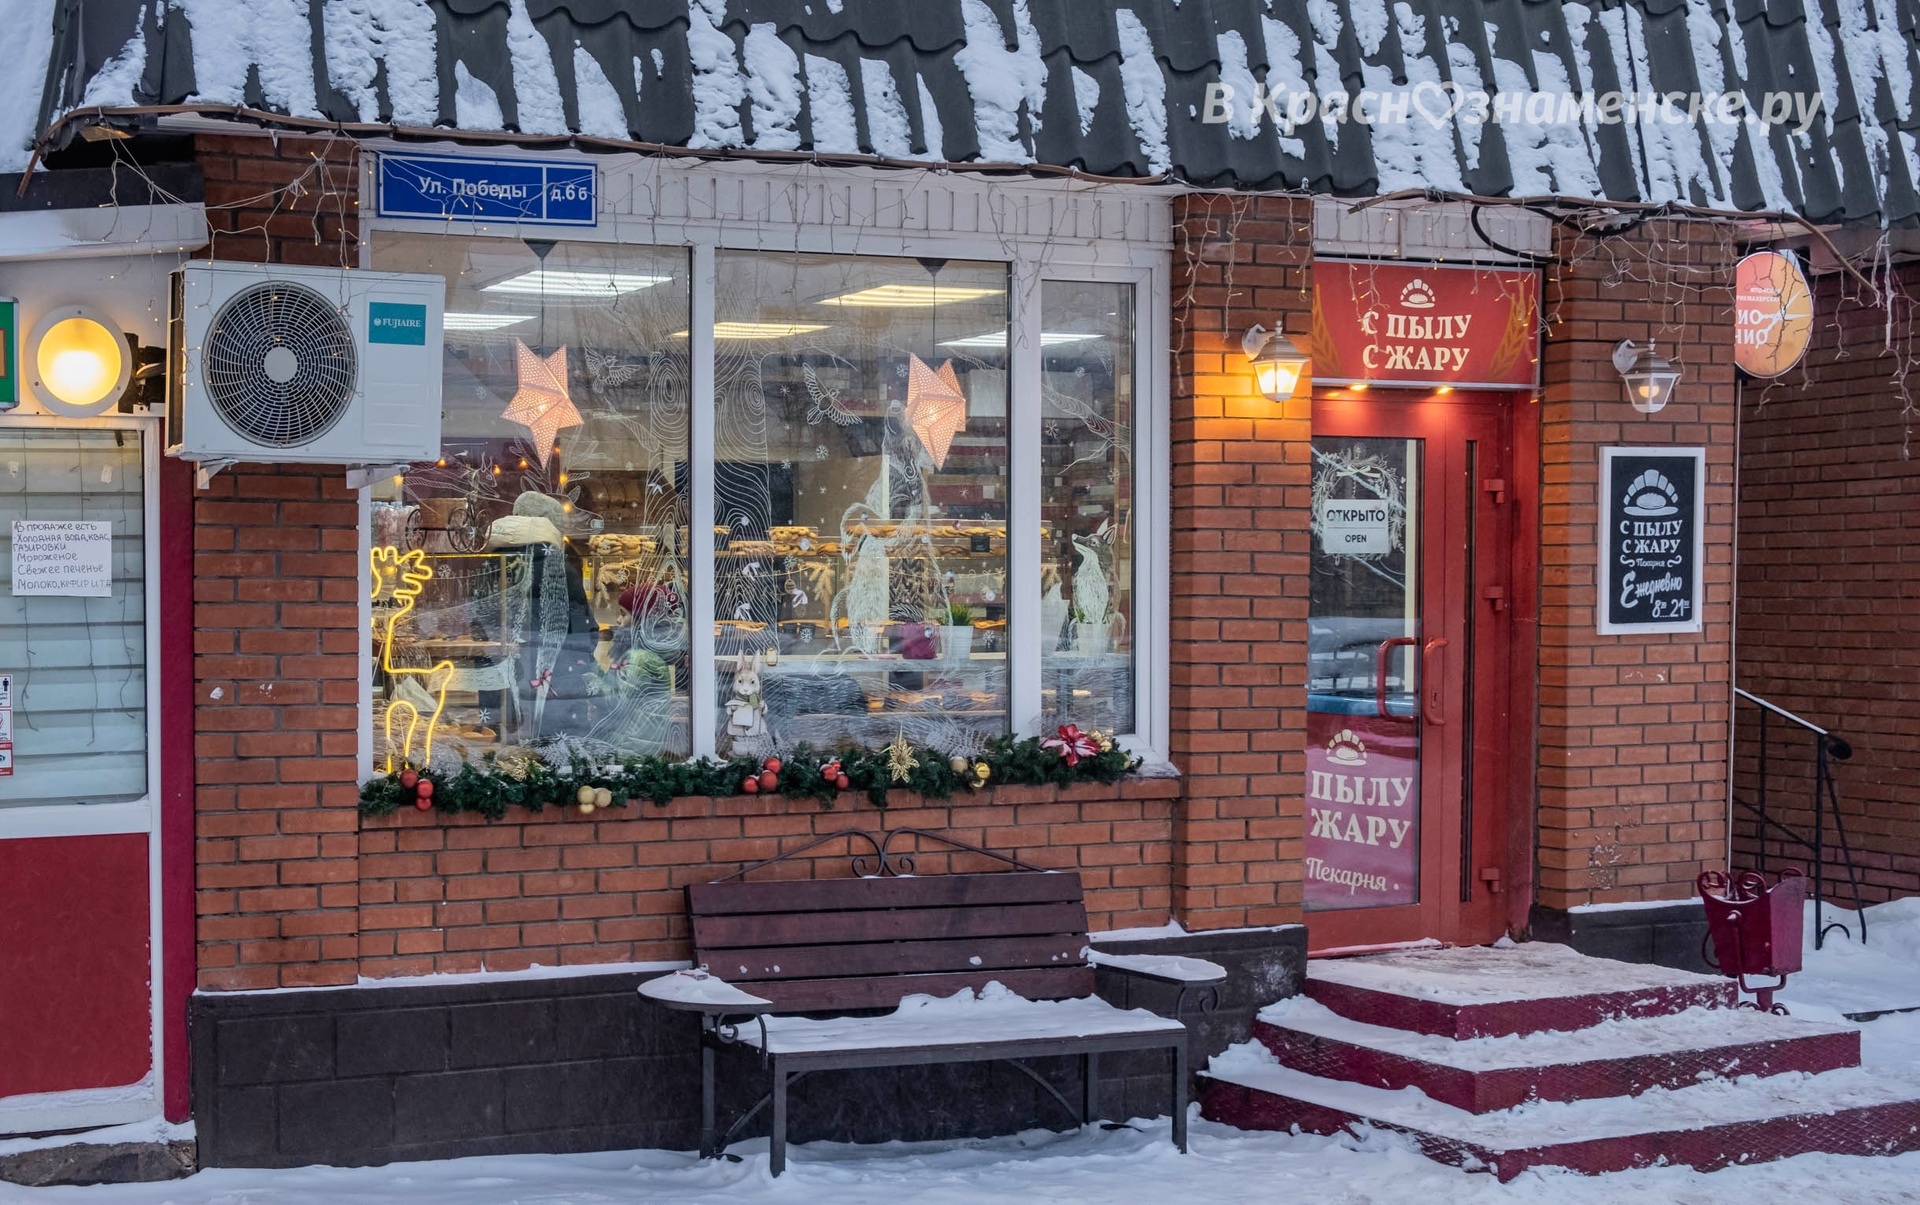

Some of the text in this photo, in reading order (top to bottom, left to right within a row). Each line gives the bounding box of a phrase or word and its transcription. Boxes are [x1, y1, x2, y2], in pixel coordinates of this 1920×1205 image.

[418, 175, 447, 195] Ул.
[453, 178, 527, 199] Победы
[382, 317, 422, 328] FUJIAIRE
[1362, 310, 1472, 339] С ПЫЛУ
[1362, 344, 1470, 371] С ЖАРУ
[1326, 509, 1386, 522] ОТКРЫТО
[1344, 534, 1367, 543] OPEN
[1620, 519, 1683, 537] С ПЫЛУ
[17, 552, 78, 562] Мороженое
[1622, 539, 1681, 554] С ЖАРУ
[18, 564, 104, 575] Свежее печенье
[1620, 570, 1683, 608] Ежедневно
[1310, 770, 1413, 807] ПЫЛУ
[1310, 808, 1412, 849] ЖАРУ
[1306, 857, 1388, 895] Пекарня
